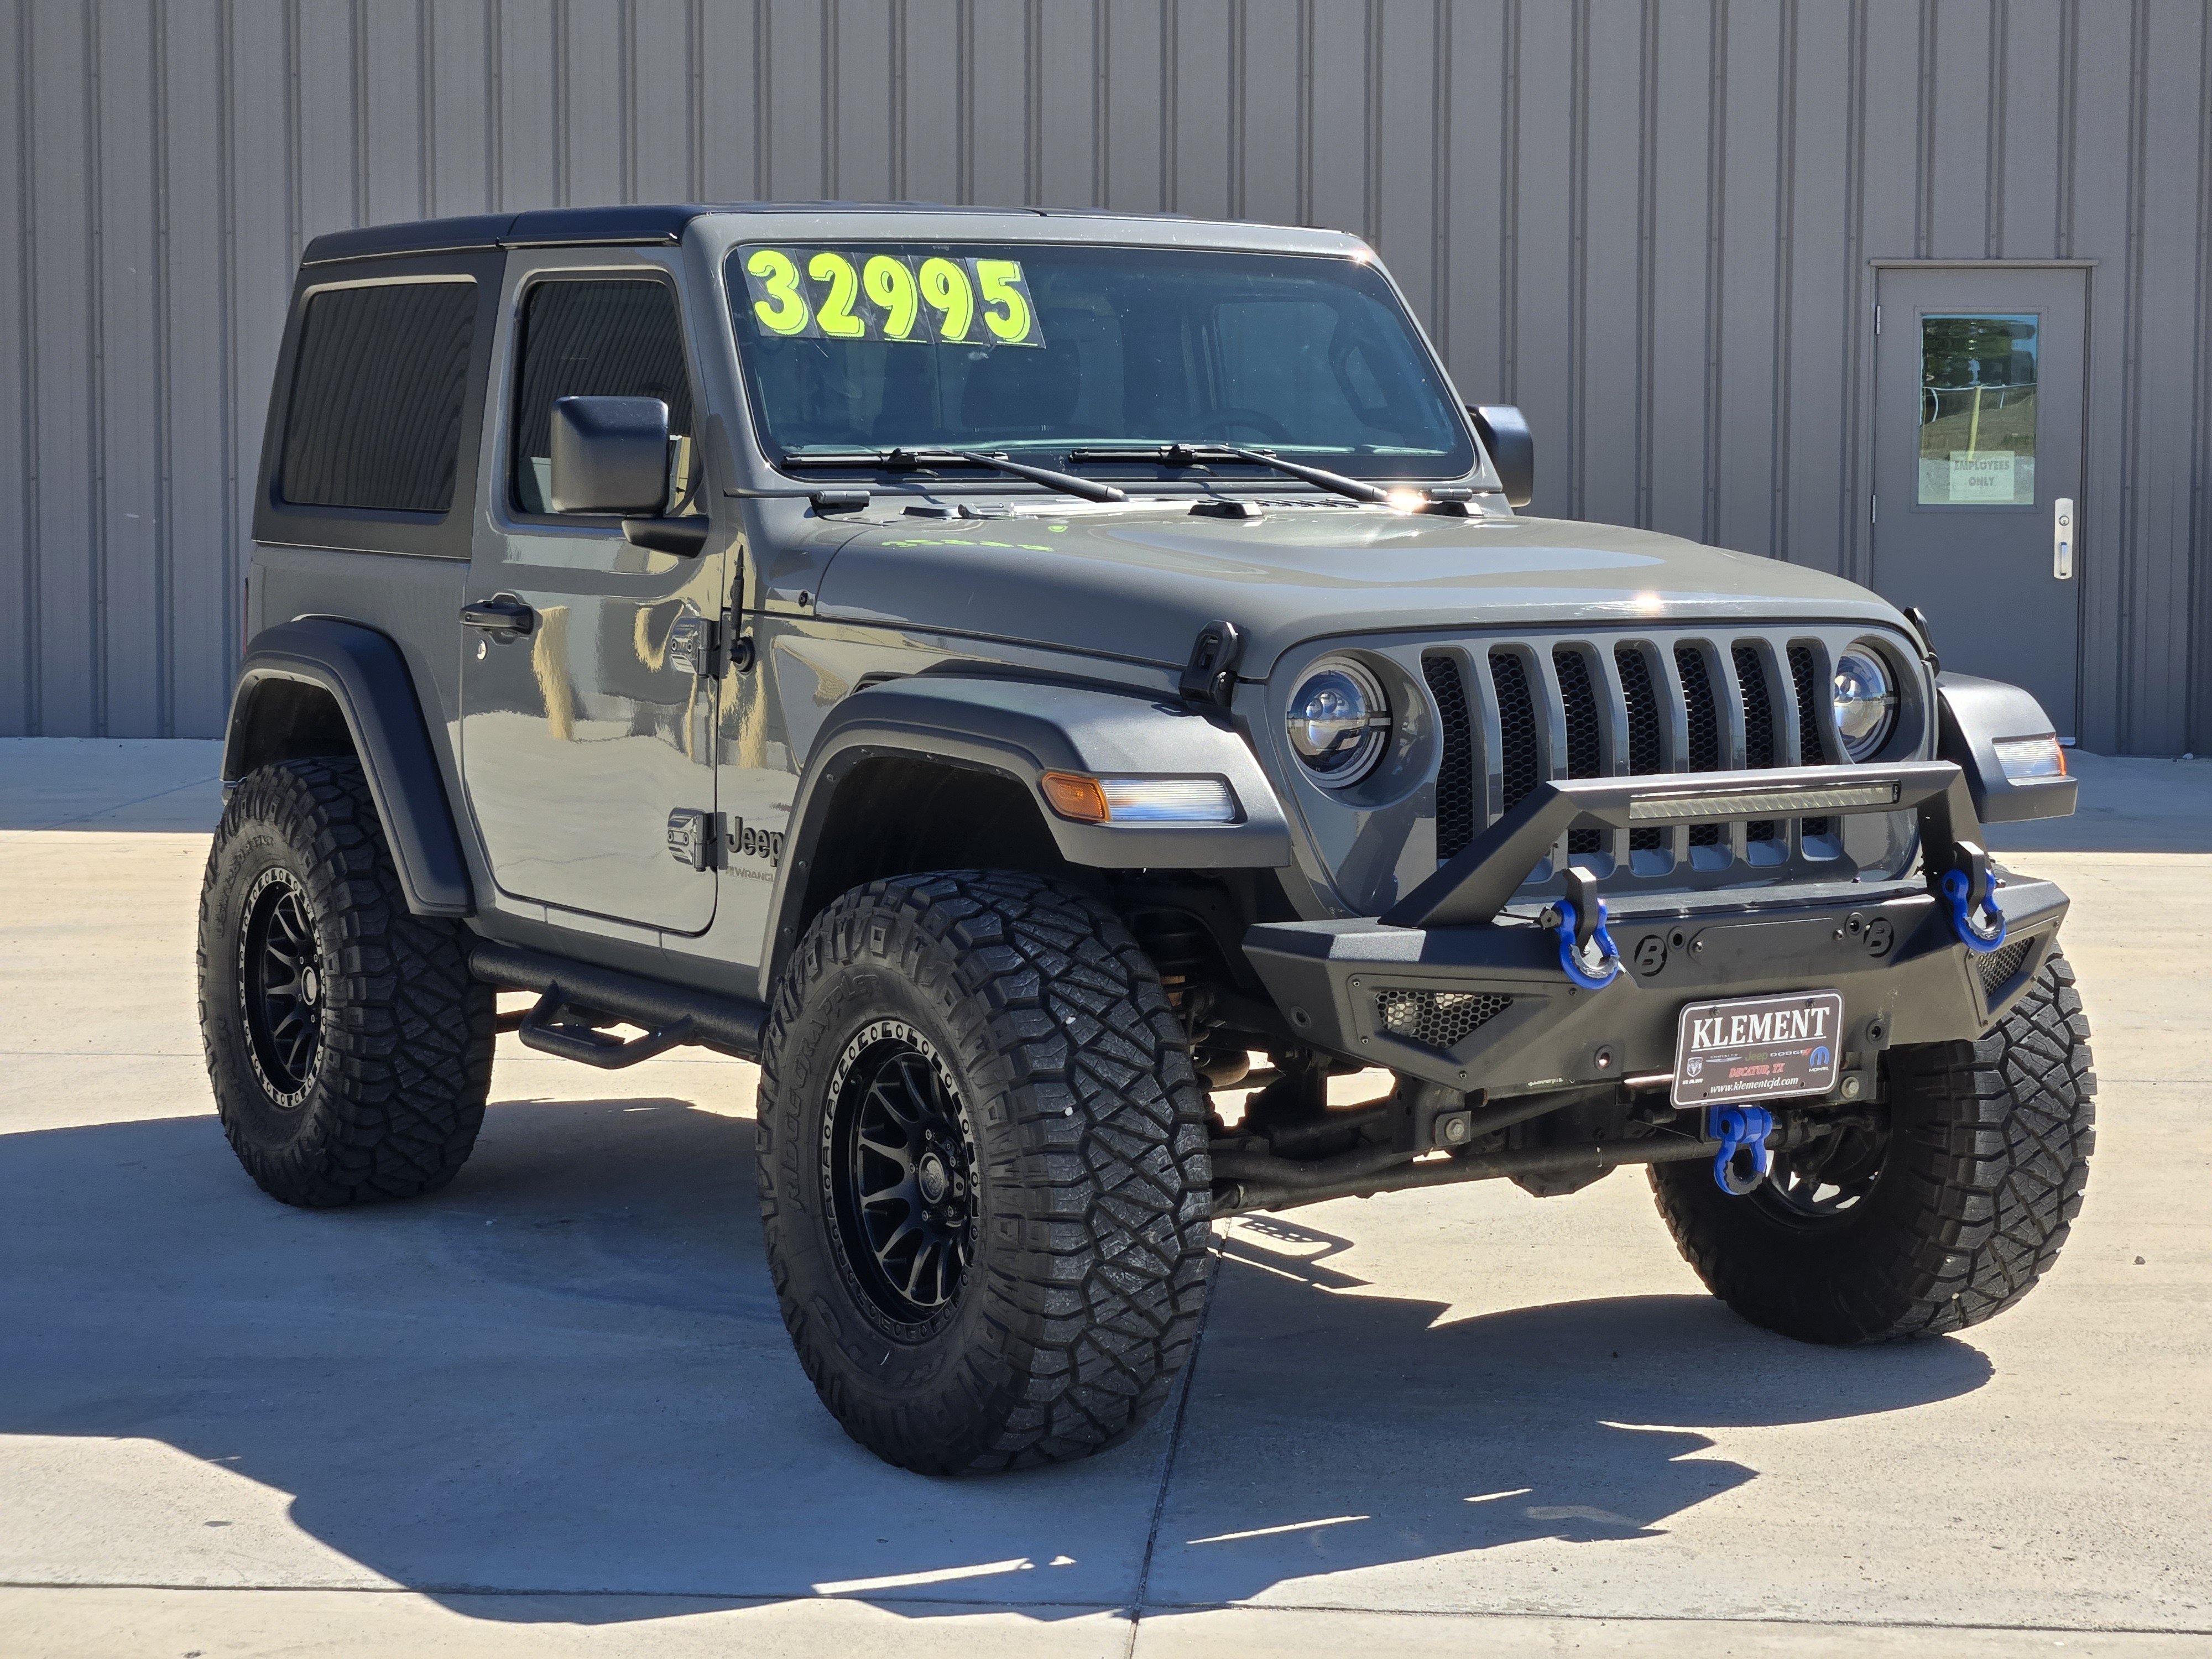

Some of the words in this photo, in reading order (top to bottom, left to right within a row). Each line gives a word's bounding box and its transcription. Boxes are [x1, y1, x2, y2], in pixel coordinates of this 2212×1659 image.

[748, 251, 1030, 342] 32995
[1954, 460, 2010, 471] EMPLOYEES
[1968, 476, 1996, 487] ONLY
[726, 816, 784, 867] Jeep
[1691, 1006, 1830, 1049] KLEMENT
[1745, 1051, 1768, 1062] Jeep
[1772, 1063, 1786, 1073] TX
[1710, 1077, 1799, 1094] www.klementcjd.com
